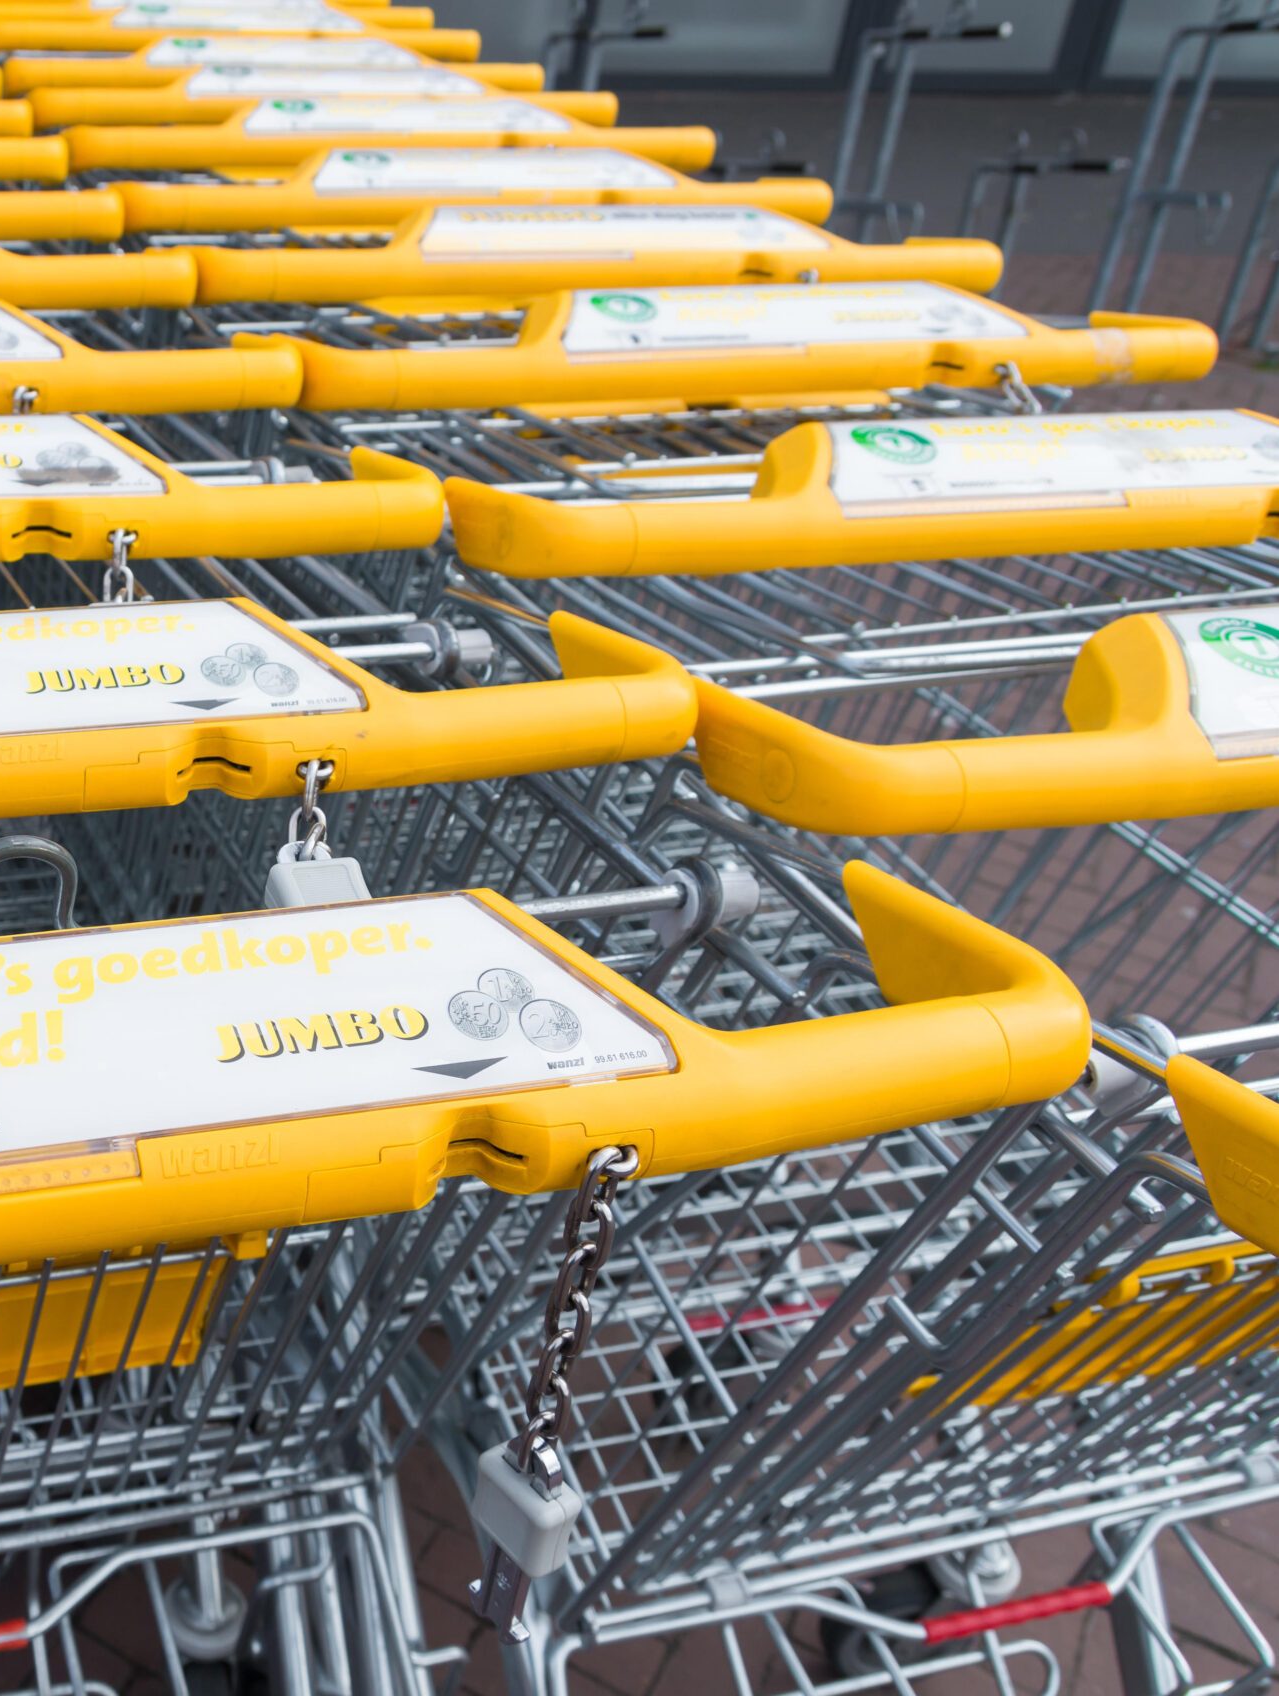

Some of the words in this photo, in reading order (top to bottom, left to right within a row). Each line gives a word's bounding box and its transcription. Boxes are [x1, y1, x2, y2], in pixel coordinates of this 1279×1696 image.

[25, 664, 186, 695] JUMBO
[52, 920, 434, 1005] goedkoper.
[216, 1004, 430, 1064] JUMBO
[547, 1057, 585, 1070] wanzl
[158, 1131, 281, 1180] wanzl
